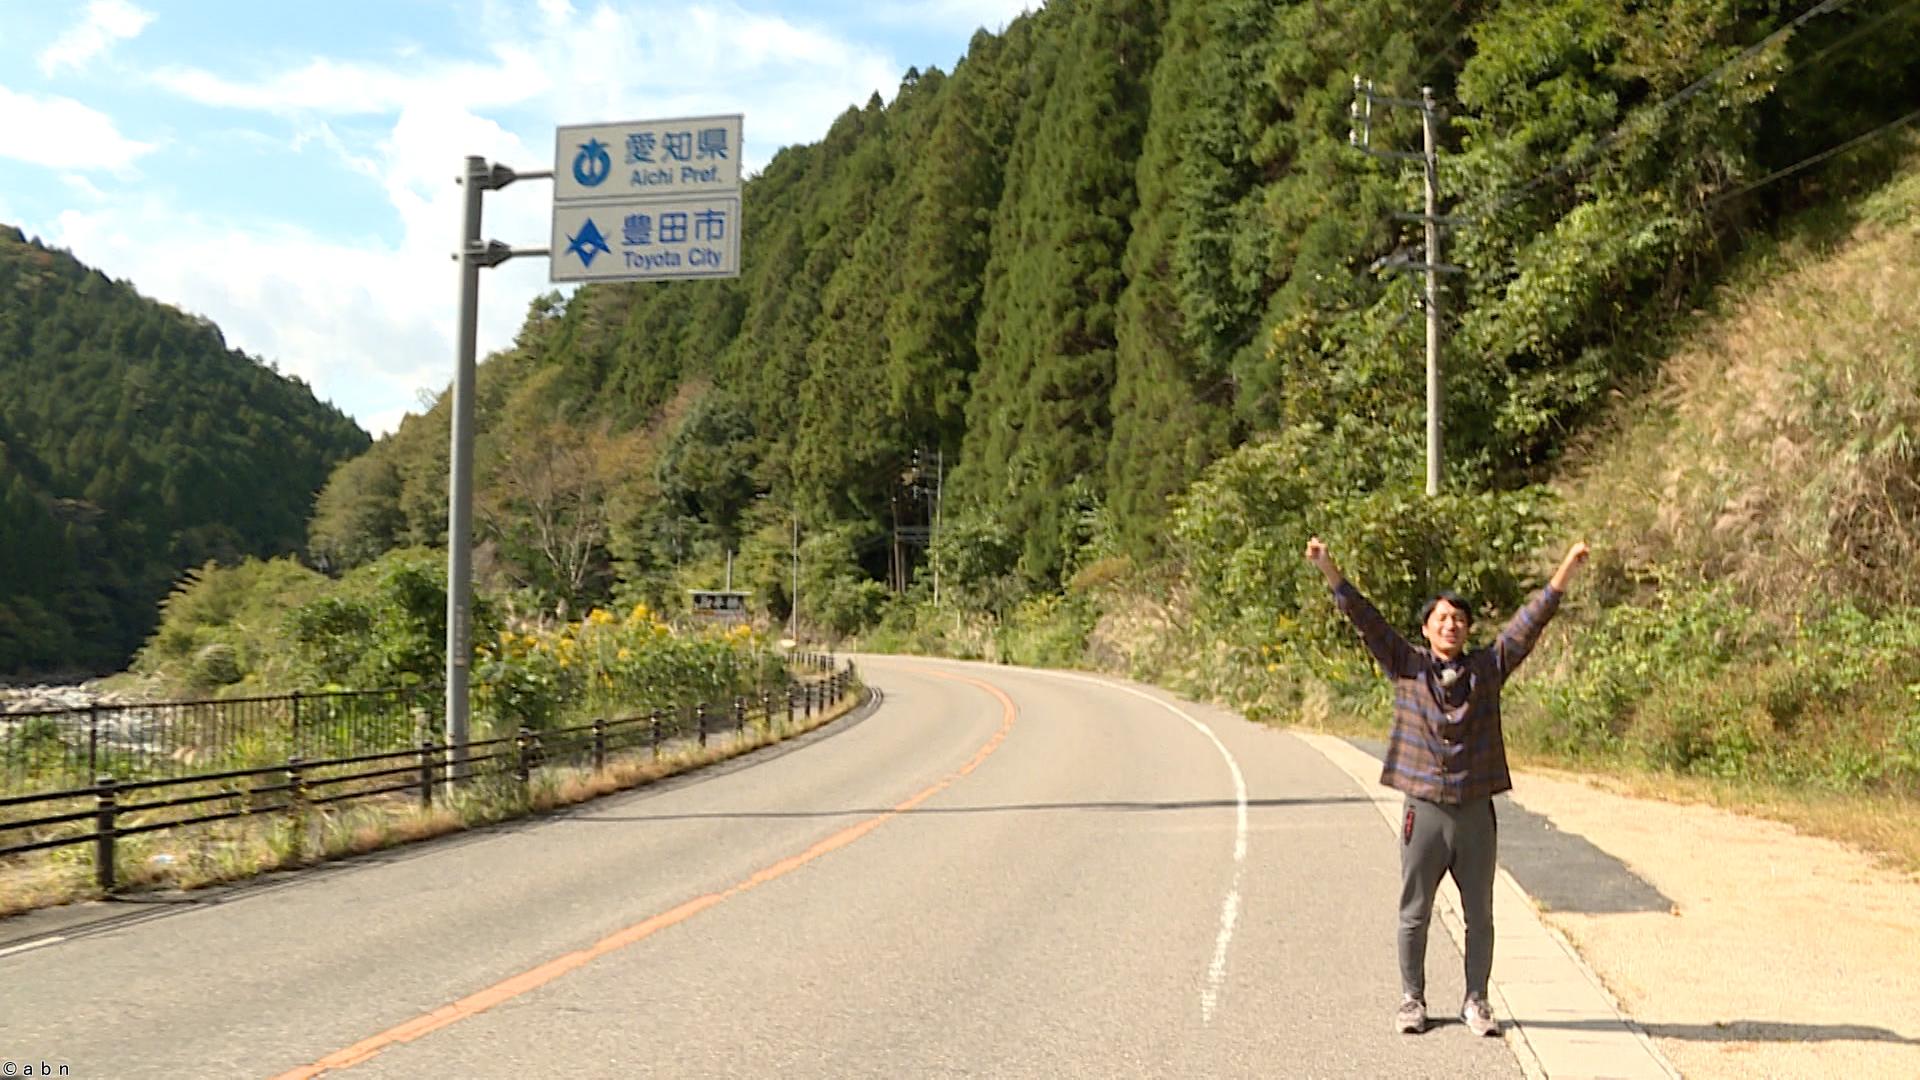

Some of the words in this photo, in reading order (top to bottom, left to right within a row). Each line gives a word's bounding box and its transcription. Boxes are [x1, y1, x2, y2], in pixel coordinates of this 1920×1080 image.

[625, 128, 728, 165] 愛知県
[631, 167, 673, 186] Aichi
[681, 165, 722, 185] Pref.
[621, 209, 726, 246] 豊田市
[623, 250, 681, 270] Toyota
[688, 248, 722, 268] City
